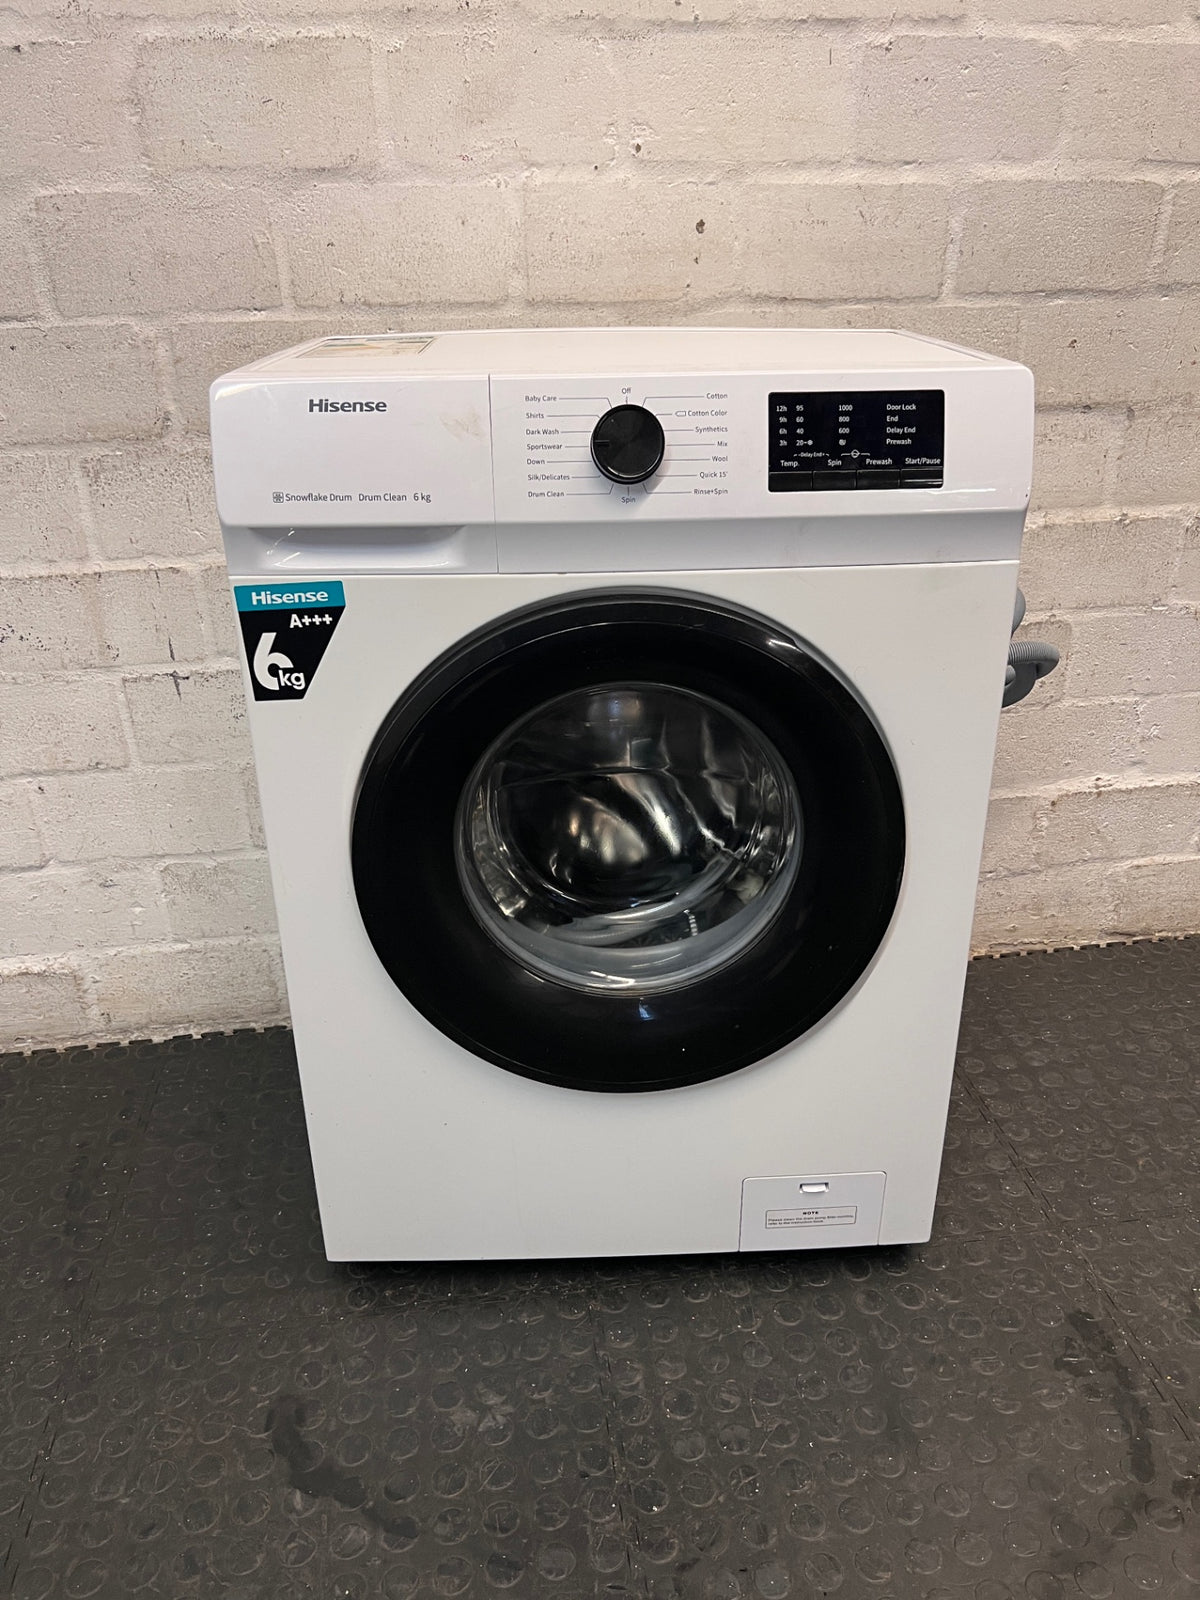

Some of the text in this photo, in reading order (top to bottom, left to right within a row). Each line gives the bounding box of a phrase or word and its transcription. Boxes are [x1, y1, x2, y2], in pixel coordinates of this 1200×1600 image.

[308, 399, 387, 413] Hisense
[695, 426, 728, 434] Synthetics
[527, 443, 562, 451] Sportswear
[828, 459, 842, 467] Spin
[905, 457, 941, 465] Start/Pause
[527, 473, 570, 481] Silk/Delicates
[285, 493, 352, 502] Snowflake Drum
[358, 493, 407, 502] Drum Clean
[413, 493, 431, 503] 6 kg
[621, 496, 636, 504] Spin
[251, 591, 328, 605] Hisense
[289, 614, 333, 628] A+++
